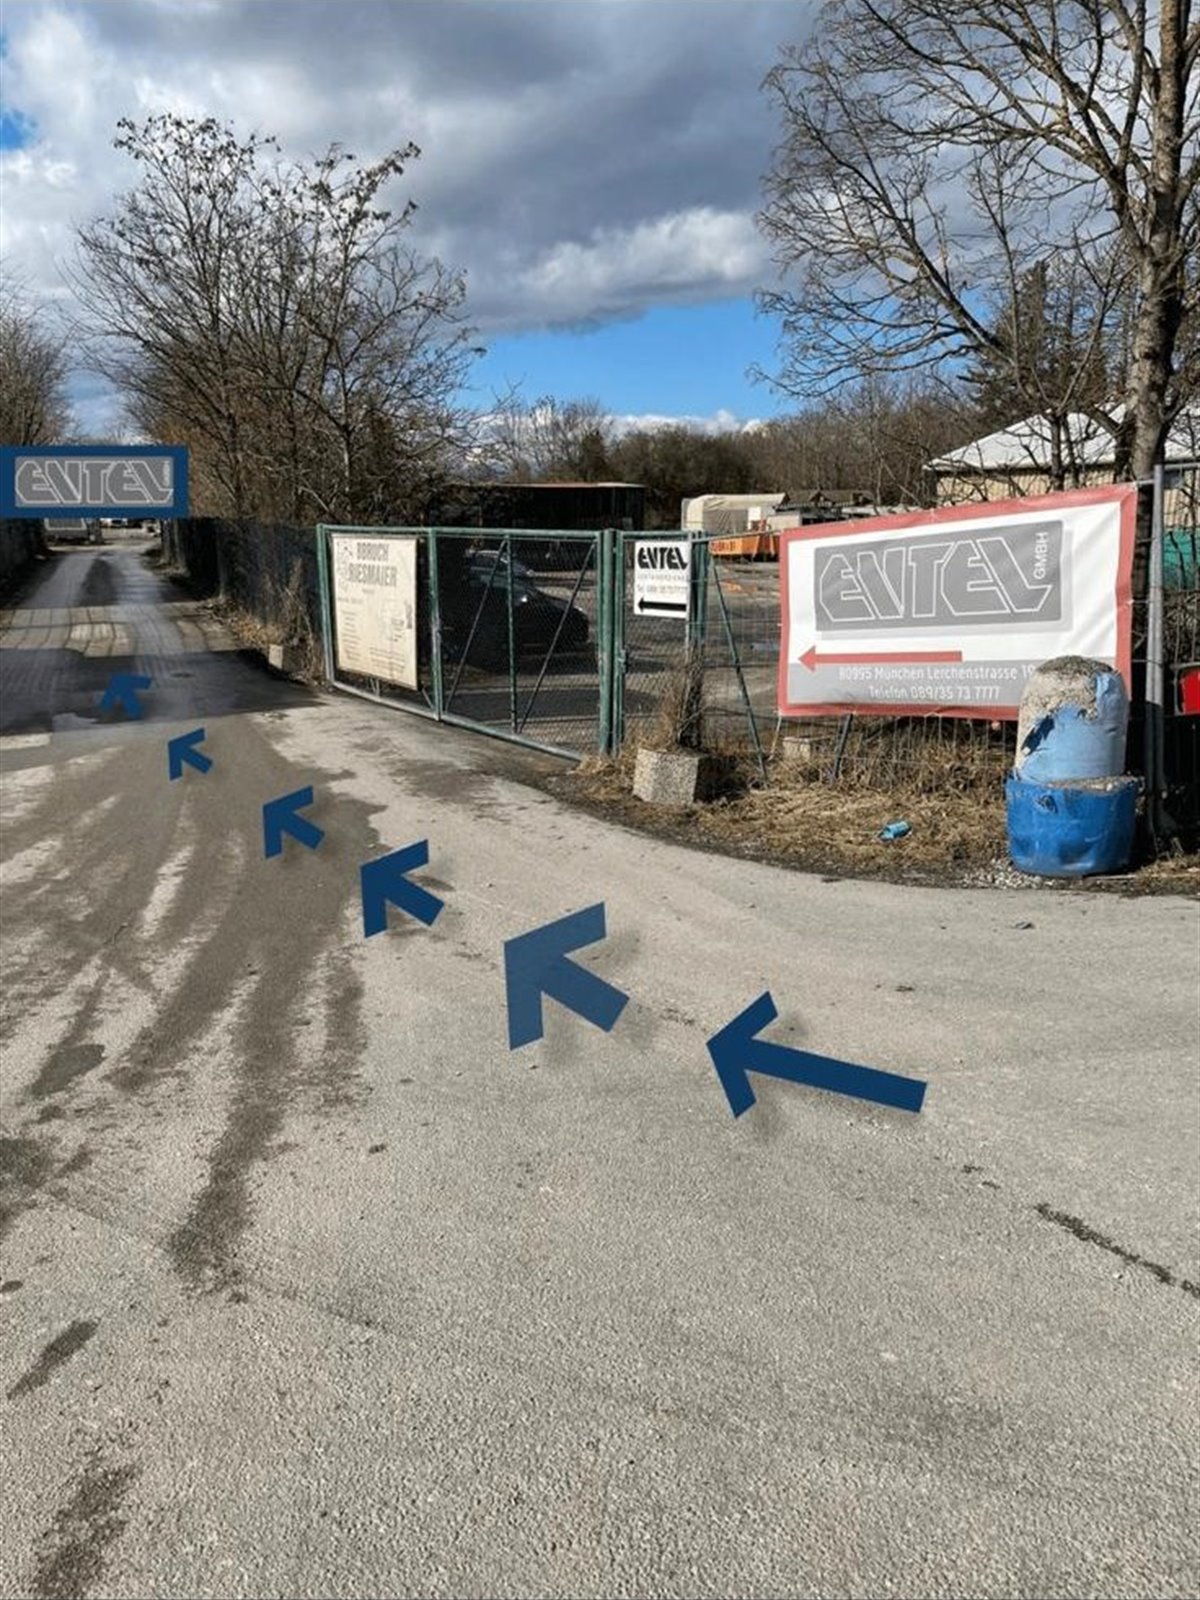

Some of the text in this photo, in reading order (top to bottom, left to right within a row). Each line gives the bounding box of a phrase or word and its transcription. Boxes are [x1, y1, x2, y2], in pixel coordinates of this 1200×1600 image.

[637, 546, 689, 570] ENTEL
[1033, 532, 1048, 580] GMBH
[819, 536, 1052, 622] ENTEL
[927, 665, 1018, 680] Lerchenstrasse
[869, 685, 908, 699] Telefon
[957, 685, 971, 700] 73
[974, 685, 1000, 699] 7777
